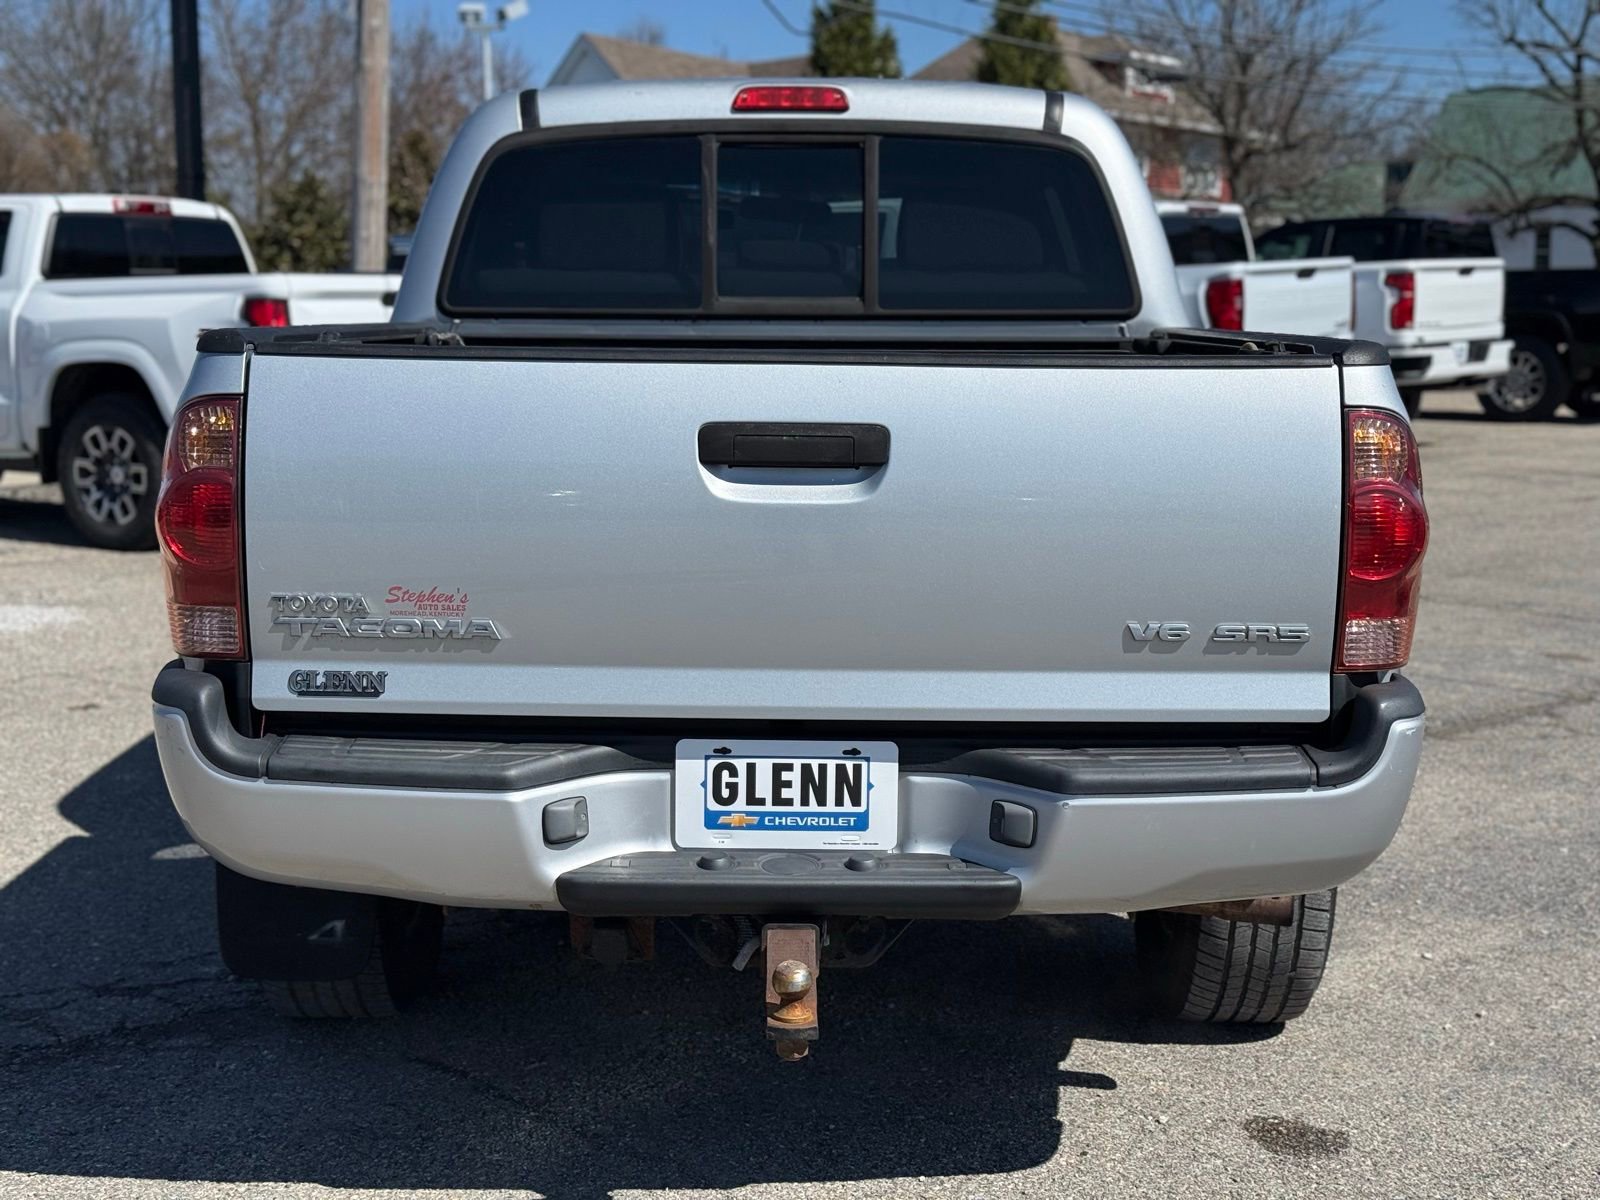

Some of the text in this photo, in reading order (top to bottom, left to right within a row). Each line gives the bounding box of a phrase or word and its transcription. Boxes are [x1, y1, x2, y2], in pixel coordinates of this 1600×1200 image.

[271, 592, 371, 613] TOYOTA
[384, 585, 470, 607] Stephen's
[417, 603, 466, 612] AUTO SALES
[273, 616, 502, 640] TACOMA
[1127, 622, 1311, 643] V6 SR5
[287, 669, 389, 696] GLENN
[711, 761, 863, 808] GLENN
[764, 816, 857, 827] CHEVROLET
